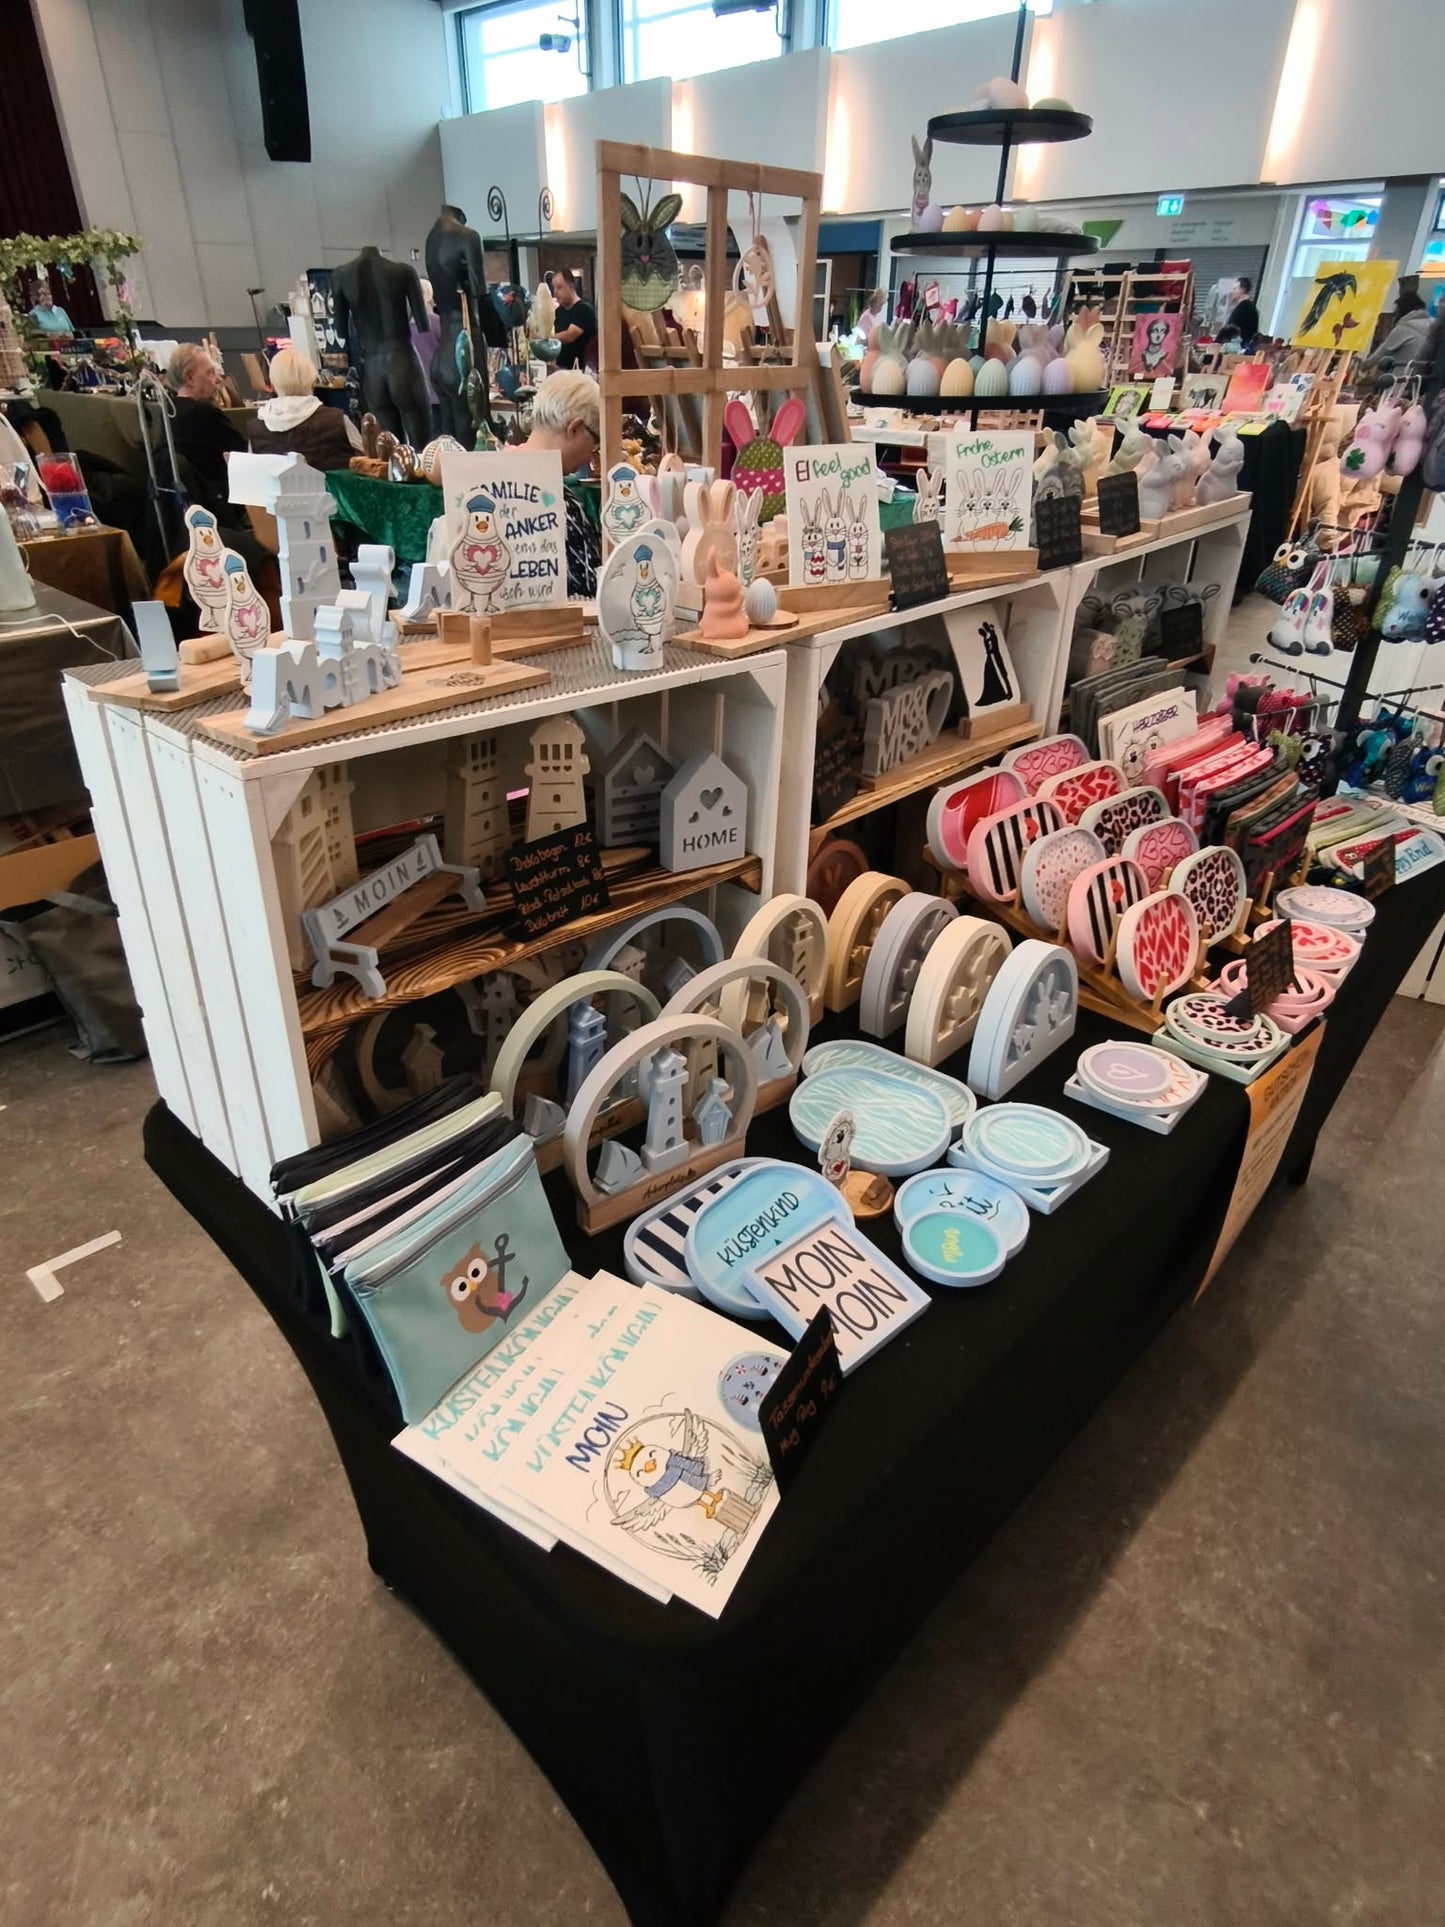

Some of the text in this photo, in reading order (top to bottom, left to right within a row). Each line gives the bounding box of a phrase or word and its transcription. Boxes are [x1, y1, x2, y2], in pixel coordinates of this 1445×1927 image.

[812, 452, 842, 478] feel
[981, 447, 1025, 468] Ostern
[840, 457, 871, 488] good
[470, 481, 541, 503] MILIE
[504, 512, 559, 540] ANKER
[529, 580, 554, 598] wird
[682, 827, 739, 853] HOME
[353, 861, 410, 914] MOIN
[764, 1229, 866, 1312] MOIN
[564, 1400, 629, 1473] MOIN
